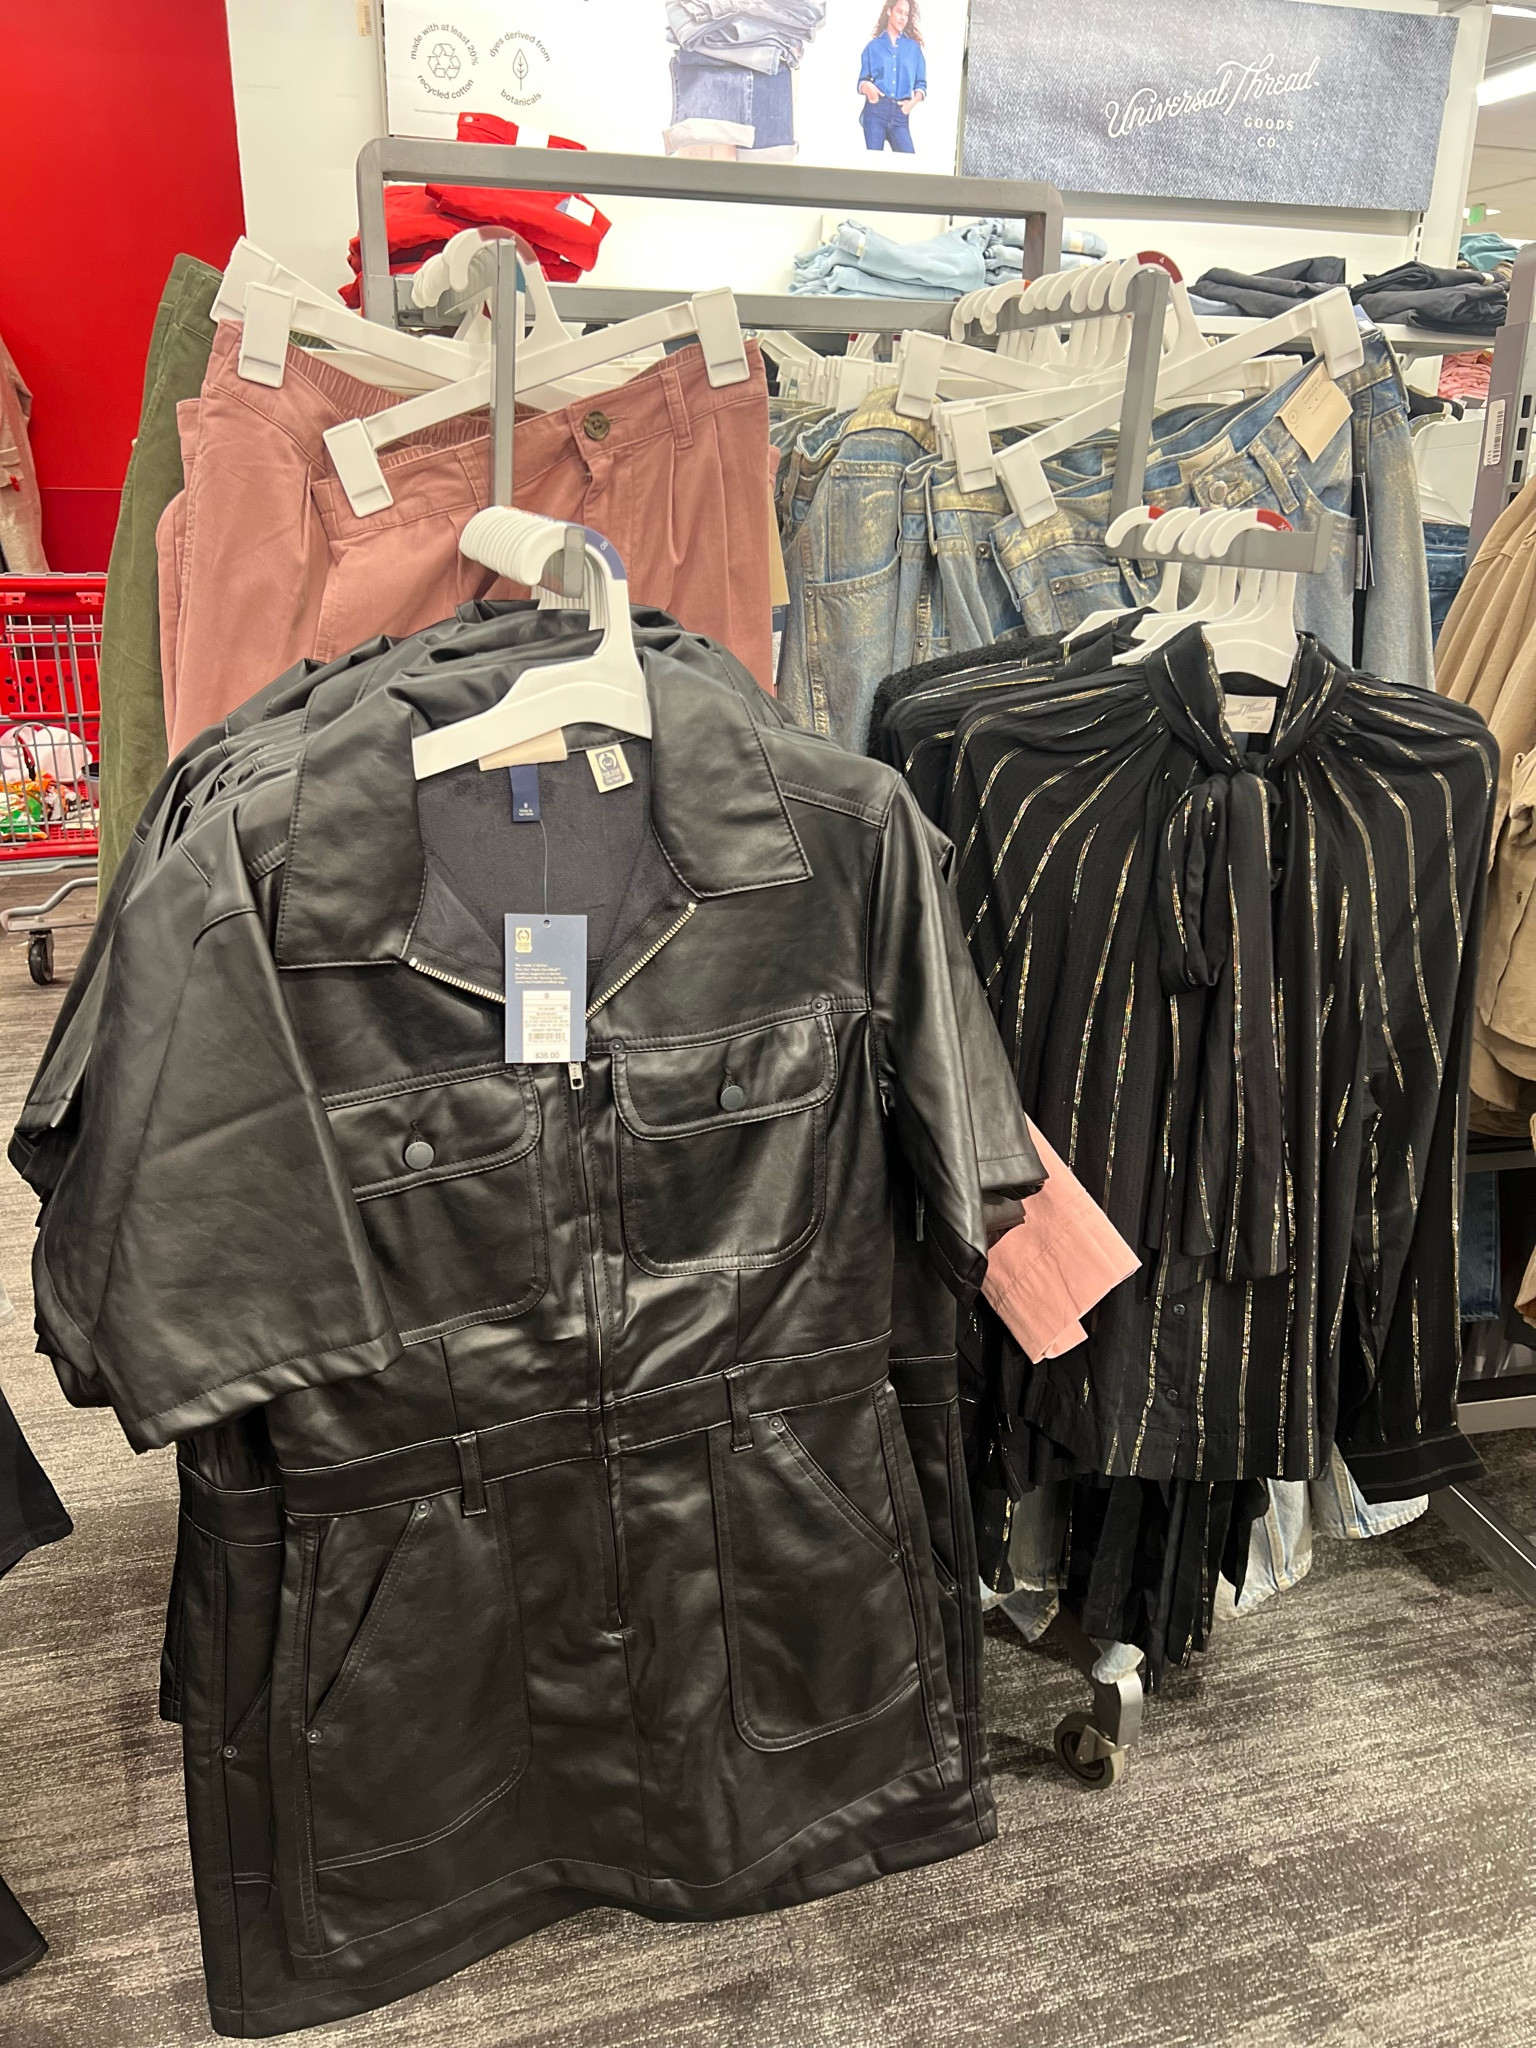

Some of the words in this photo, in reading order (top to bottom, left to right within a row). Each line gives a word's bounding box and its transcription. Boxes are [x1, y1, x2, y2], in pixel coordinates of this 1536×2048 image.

[410, 34, 423, 60] made
[421, 23, 440, 36] with
[441, 23, 450, 32] at
[450, 25, 471, 46] least
[467, 44, 480, 66] 20%
[489, 38, 505, 58] dyes
[504, 30, 537, 43] derived
[536, 41, 551, 62] from
[417, 74, 450, 100] recycled
[451, 79, 475, 100] cotton
[500, 89, 542, 106] botanicals
[1104, 69, 1234, 139] Universal
[1213, 53, 1322, 116] Thread
[1243, 117, 1295, 131] GOODS
[1159, 256, 1165, 265] 4
[600, 541, 608, 551] 8
